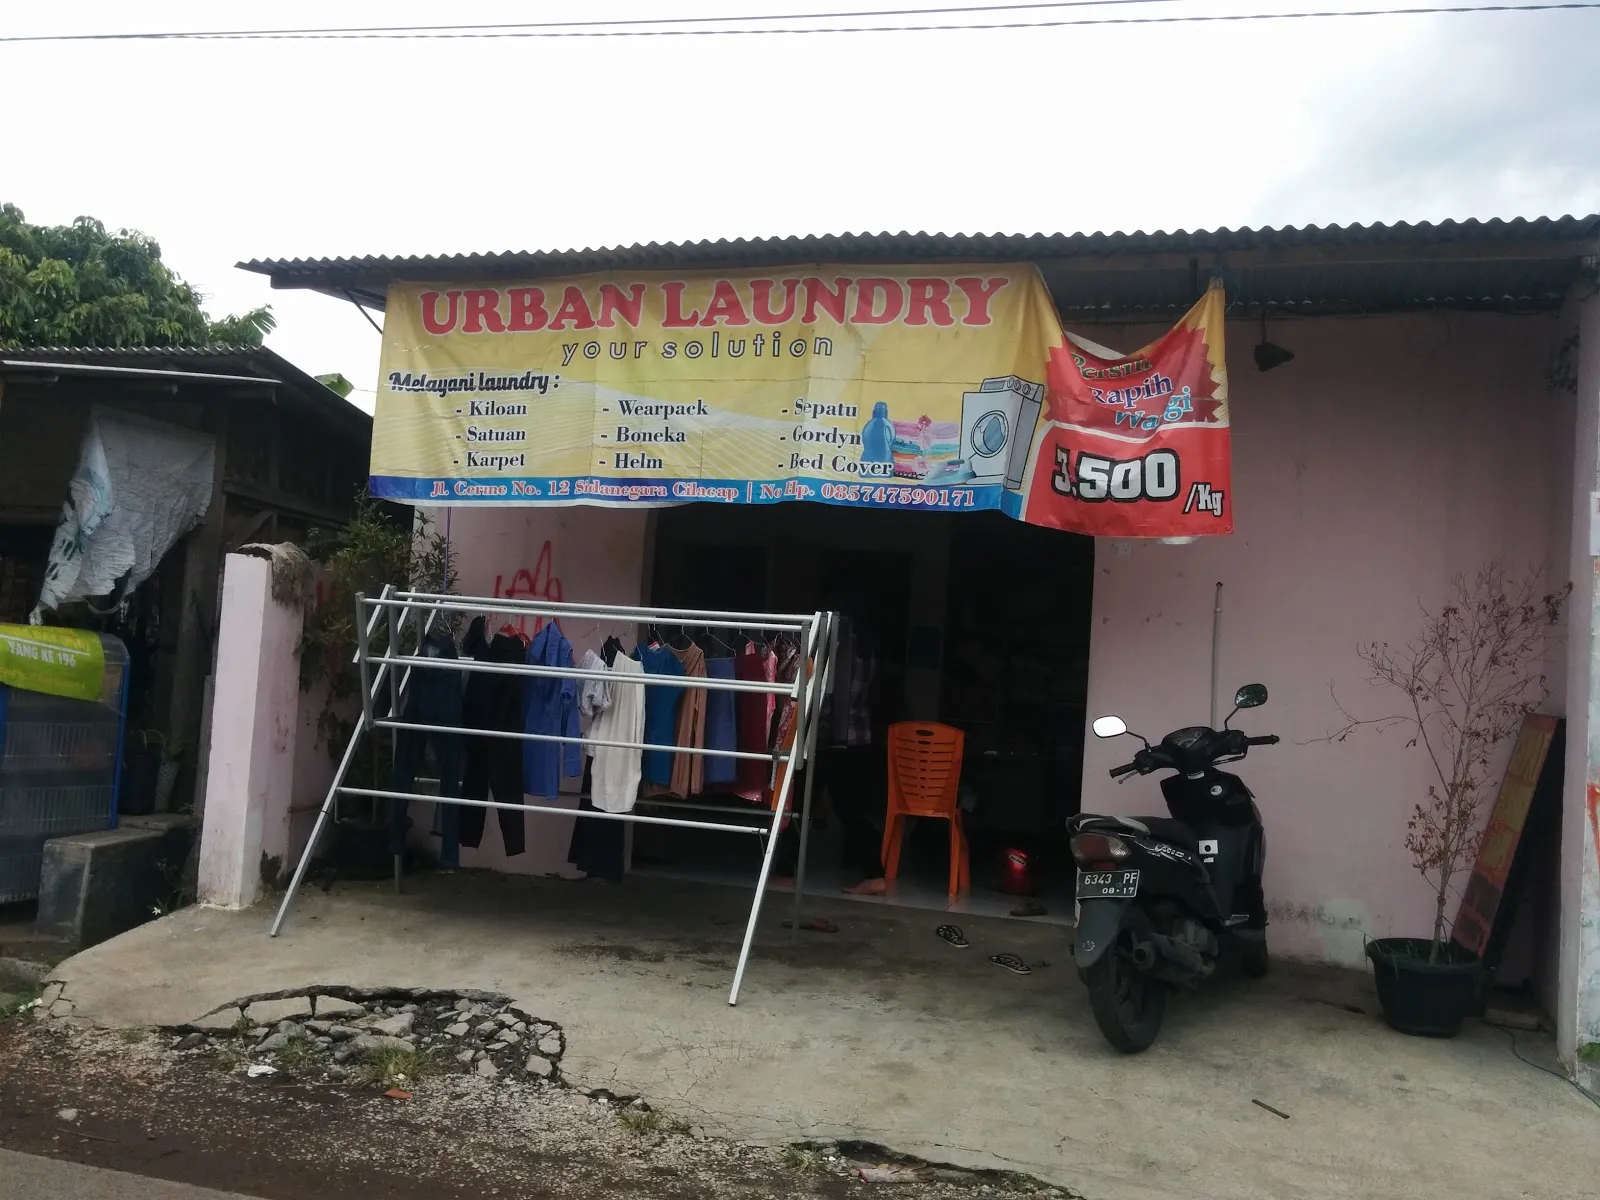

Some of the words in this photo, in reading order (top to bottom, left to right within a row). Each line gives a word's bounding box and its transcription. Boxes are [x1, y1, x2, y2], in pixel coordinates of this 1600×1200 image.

[420, 284, 646, 335] URBAN
[661, 276, 1009, 328] LAUNDRY
[562, 339, 648, 366] your
[661, 331, 833, 359] solution
[388, 372, 475, 398] Melayani
[468, 400, 528, 417] Kiloan
[618, 399, 709, 420] Wearpack
[794, 399, 858, 419] Sepatu
[466, 425, 526, 443] Satuan
[616, 426, 687, 443] Boneka
[792, 426, 862, 448] Gordyn
[466, 452, 526, 472] Karpet
[613, 453, 664, 470] Helm
[788, 452, 824, 471] Bed
[831, 455, 893, 476] Cover
[454, 480, 507, 496] Cerme
[511, 480, 541, 496] No.
[548, 481, 570, 496] 12
[574, 479, 667, 500] Sidanegara
[672, 481, 739, 502] Cilacap
[760, 484, 782, 499] No
[821, 482, 975, 507] 085747590171
[1181, 481, 1224, 517] /Kg
[1084, 873, 1113, 885] 6343
[1122, 872, 1138, 885] PF
